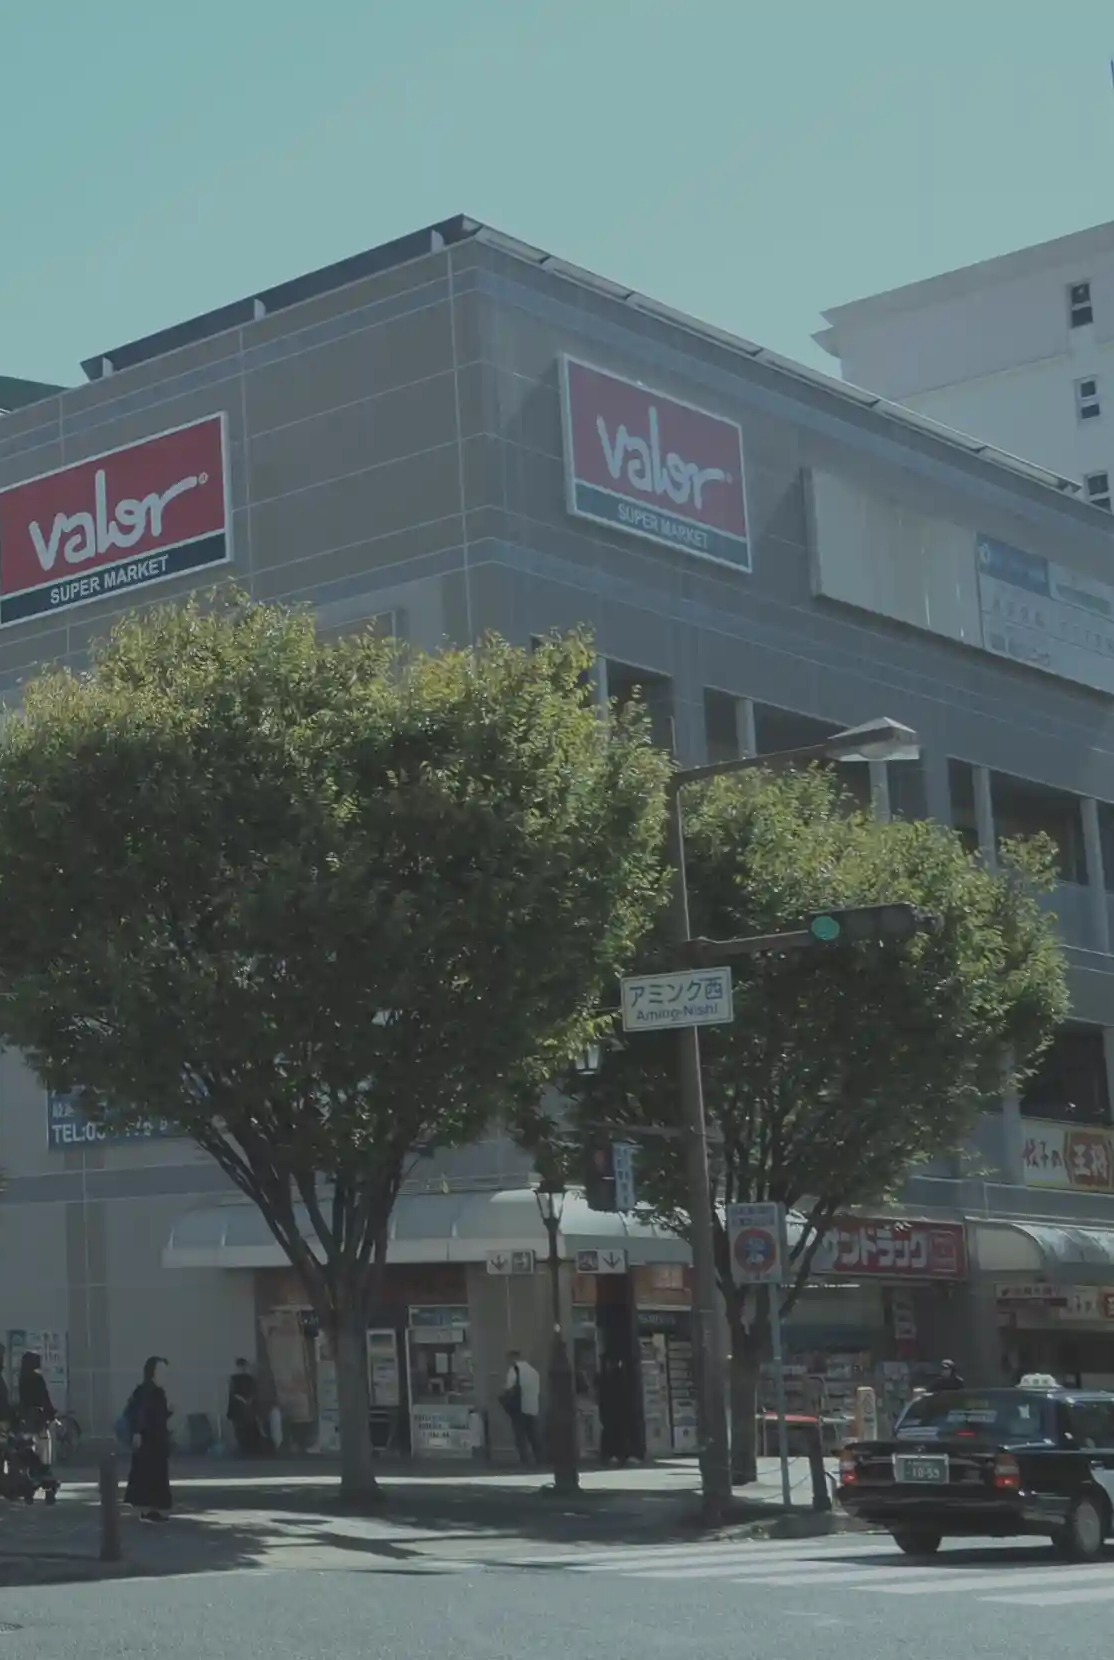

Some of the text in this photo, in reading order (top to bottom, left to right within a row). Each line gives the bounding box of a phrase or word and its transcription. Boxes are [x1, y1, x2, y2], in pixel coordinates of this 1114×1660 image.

[617, 502, 709, 550] SUPER MARKET
[50, 554, 169, 605] SUPER MARKET
[629, 976, 723, 1008] アミング西
[636, 1002, 719, 1022] Aming-Nishi
